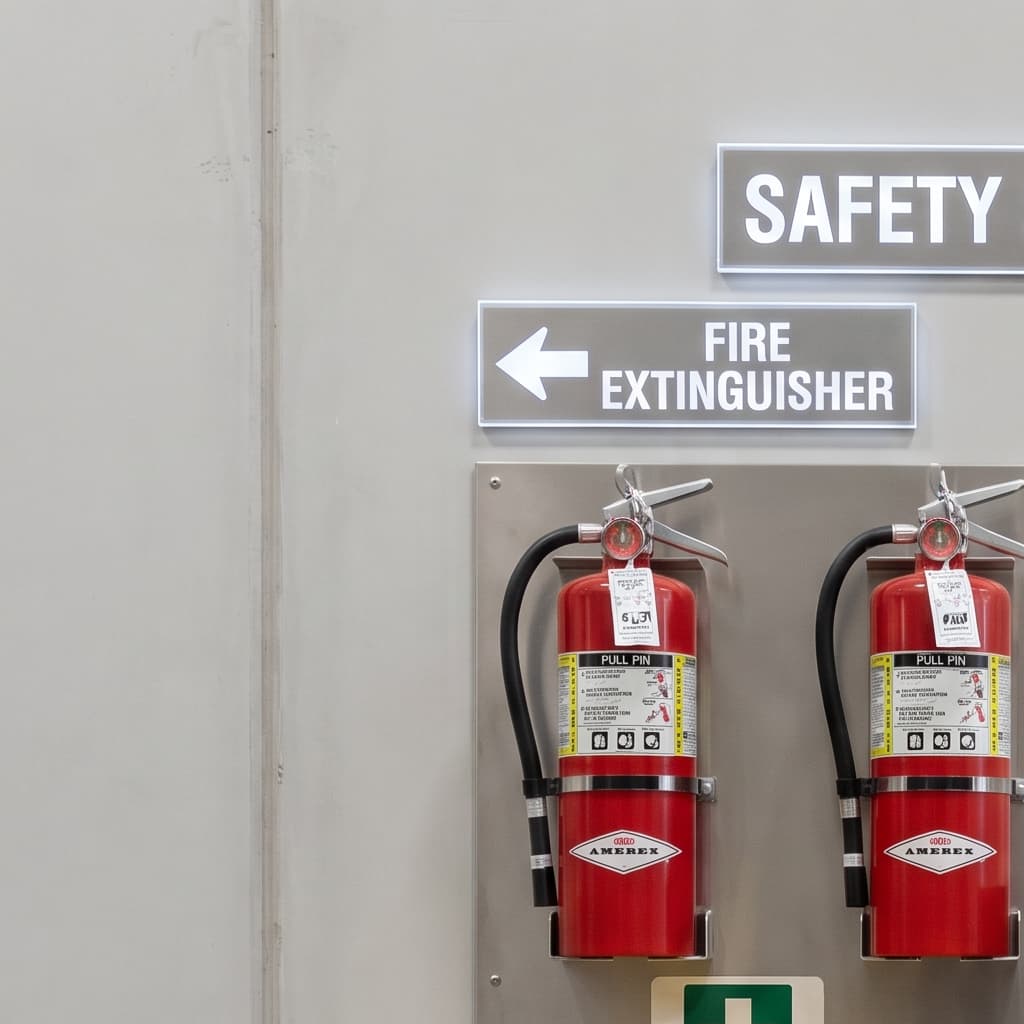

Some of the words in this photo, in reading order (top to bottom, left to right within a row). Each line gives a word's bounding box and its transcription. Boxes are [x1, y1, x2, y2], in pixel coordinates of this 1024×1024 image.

[745, 174, 1003, 244] SAFETY
[705, 322, 791, 362] FIRE
[601, 370, 894, 411] EXTINGUISHER
[601, 655, 628, 665] PULL
[632, 655, 651, 665] PIN
[916, 655, 944, 665] PULL
[947, 655, 966, 665] PIN
